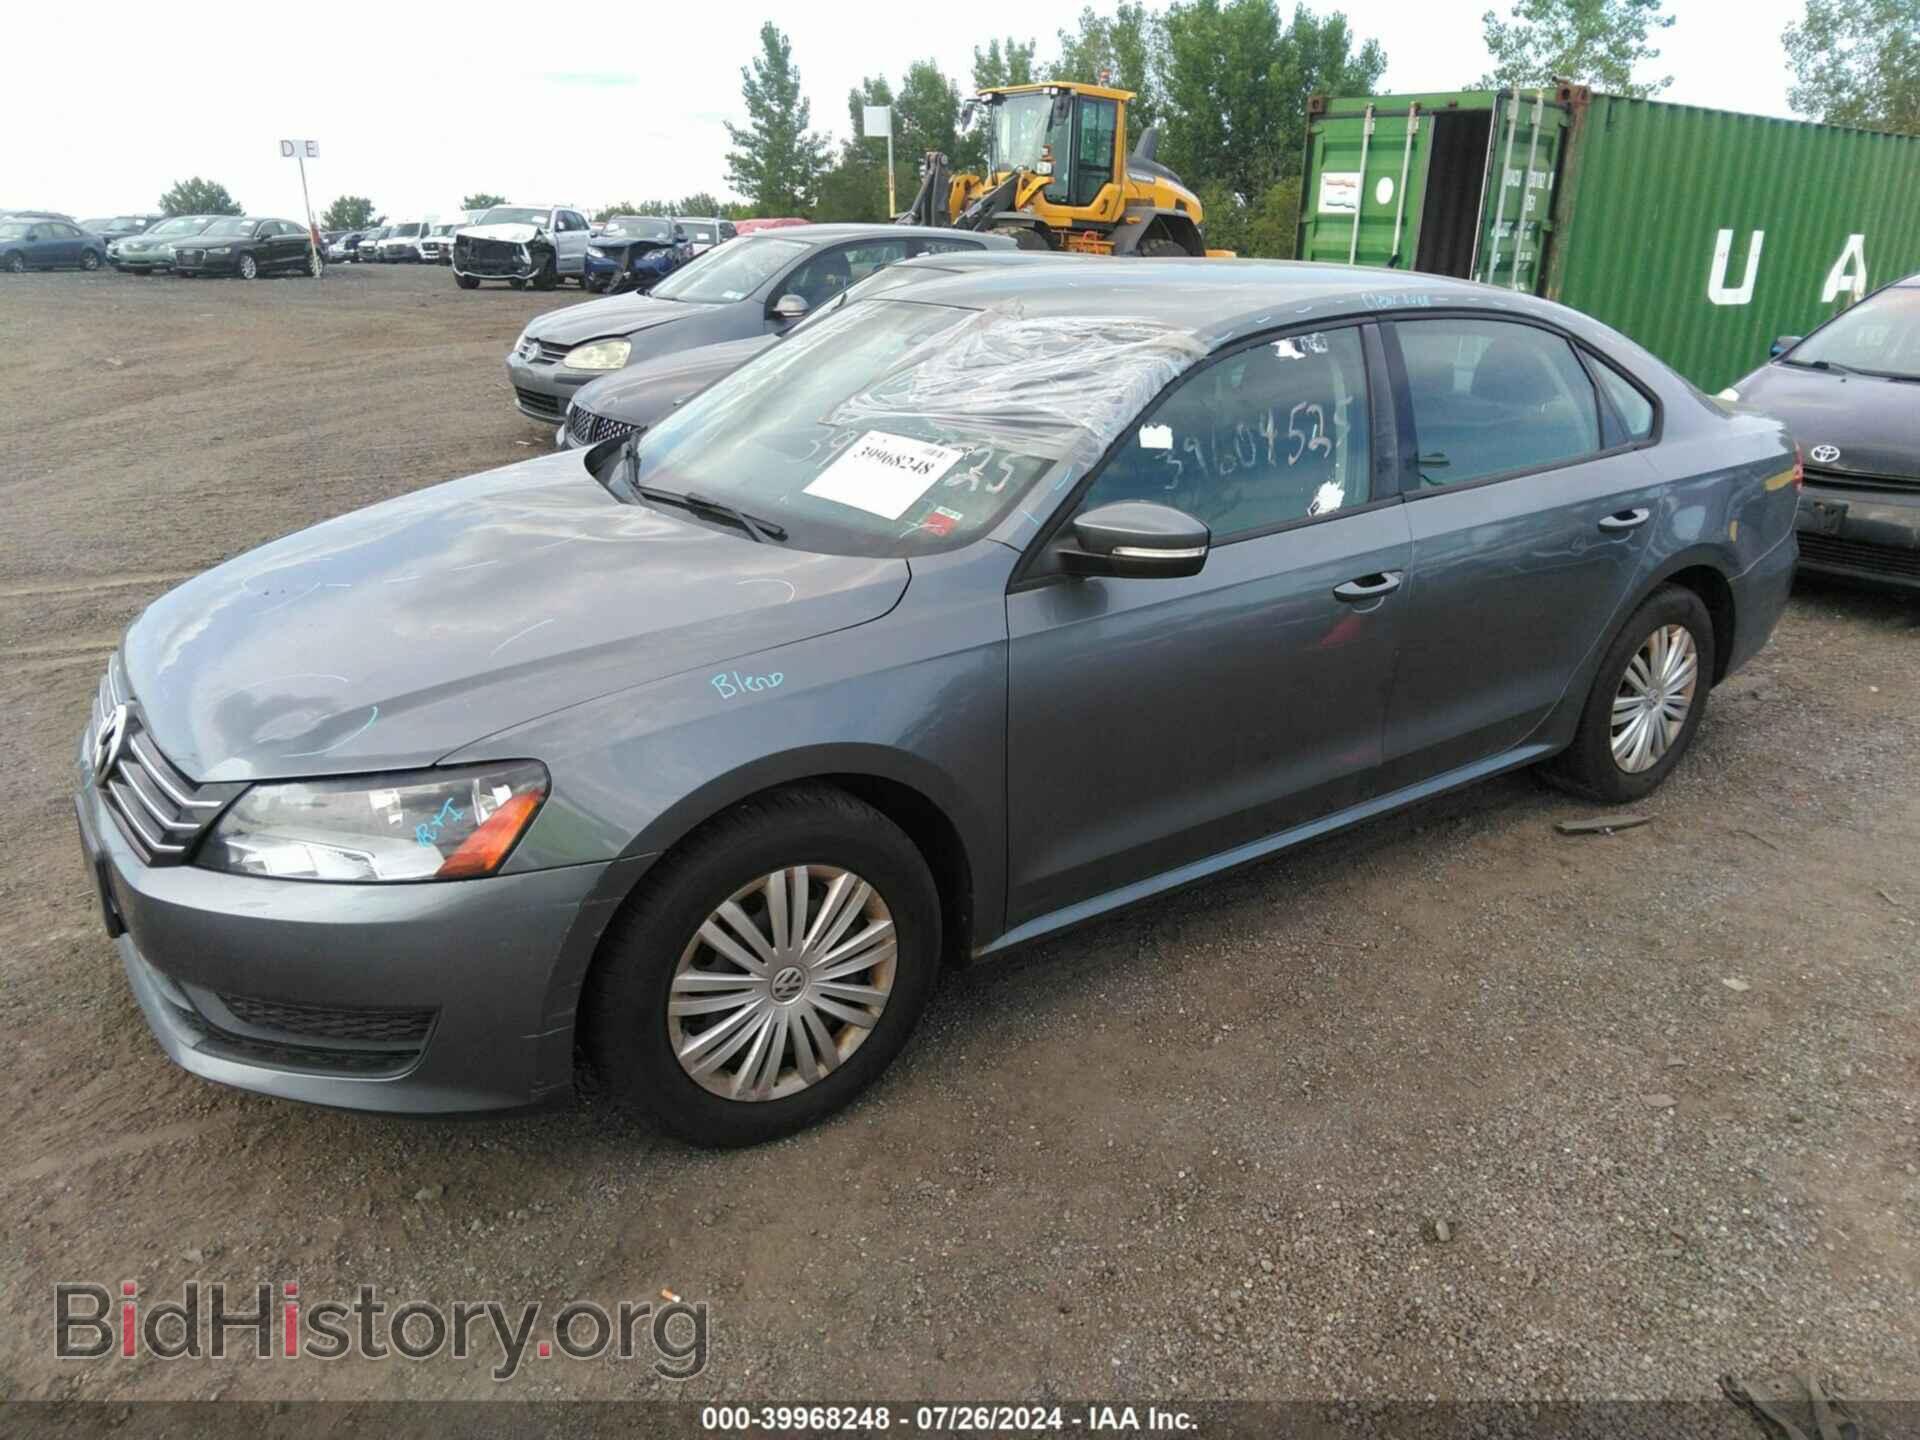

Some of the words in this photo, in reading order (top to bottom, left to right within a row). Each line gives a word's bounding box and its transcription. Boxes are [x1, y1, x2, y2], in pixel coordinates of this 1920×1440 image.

[280, 139, 296, 158] D
[304, 139, 318, 158] E
[853, 445, 936, 475] 39968248
